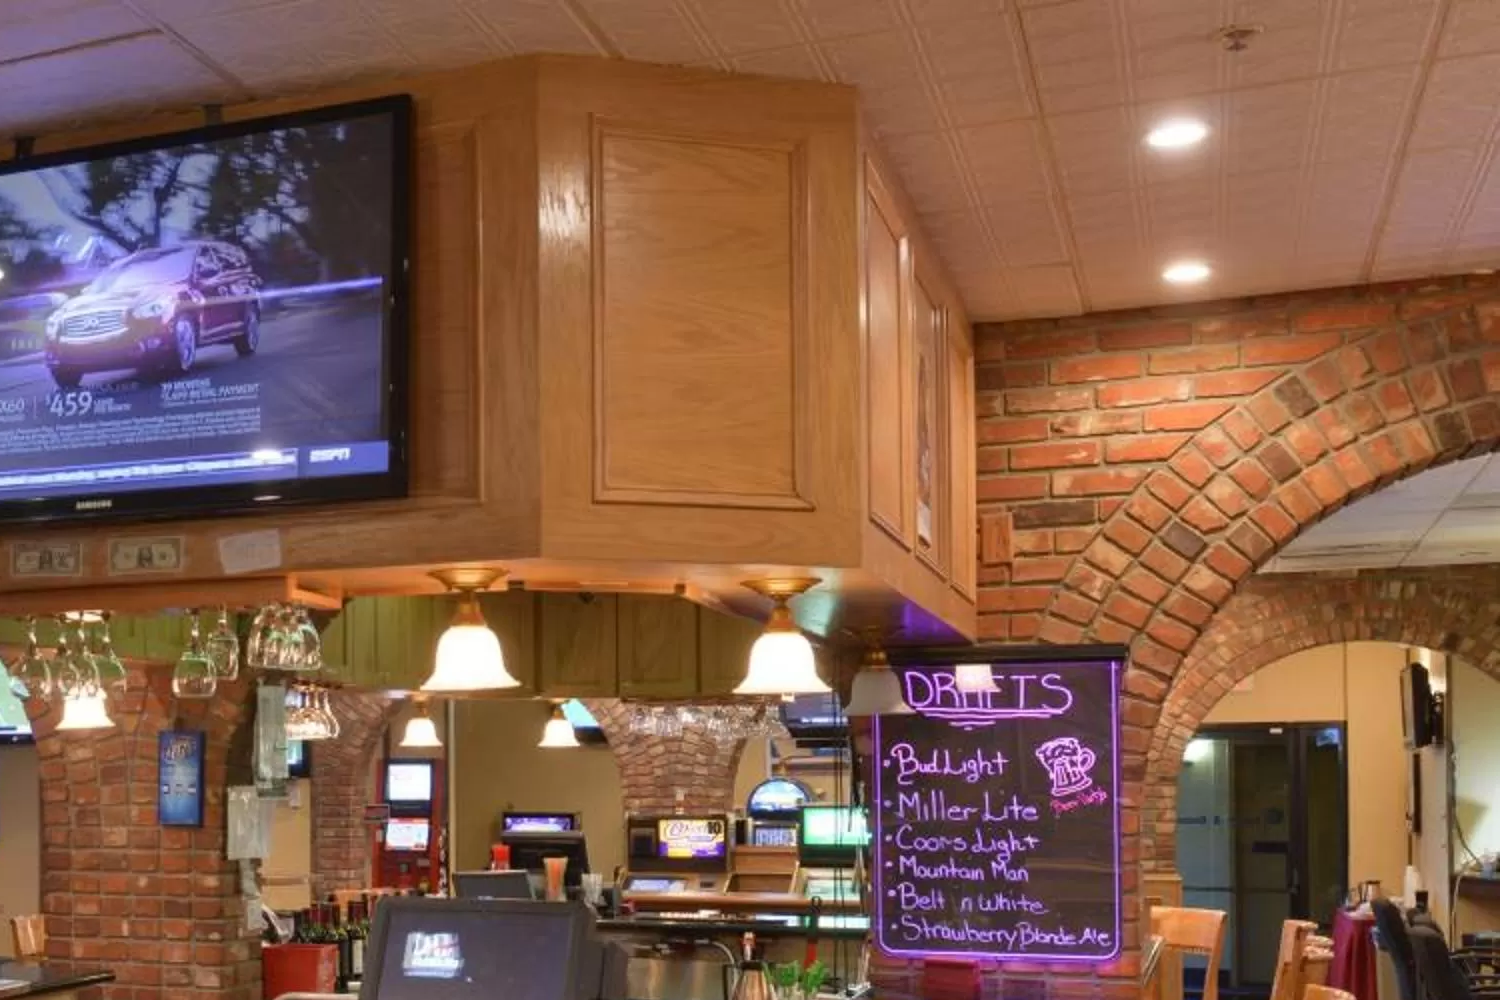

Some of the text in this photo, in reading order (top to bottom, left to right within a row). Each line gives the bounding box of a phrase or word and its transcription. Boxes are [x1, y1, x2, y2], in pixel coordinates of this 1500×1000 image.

[898, 789, 979, 821] Miller
[982, 790, 1040, 821] Lite
[896, 824, 1040, 862] Coors Light
[899, 855, 1029, 882] Mountain Man
[901, 914, 1112, 950] Strawberry Blonde Ale
